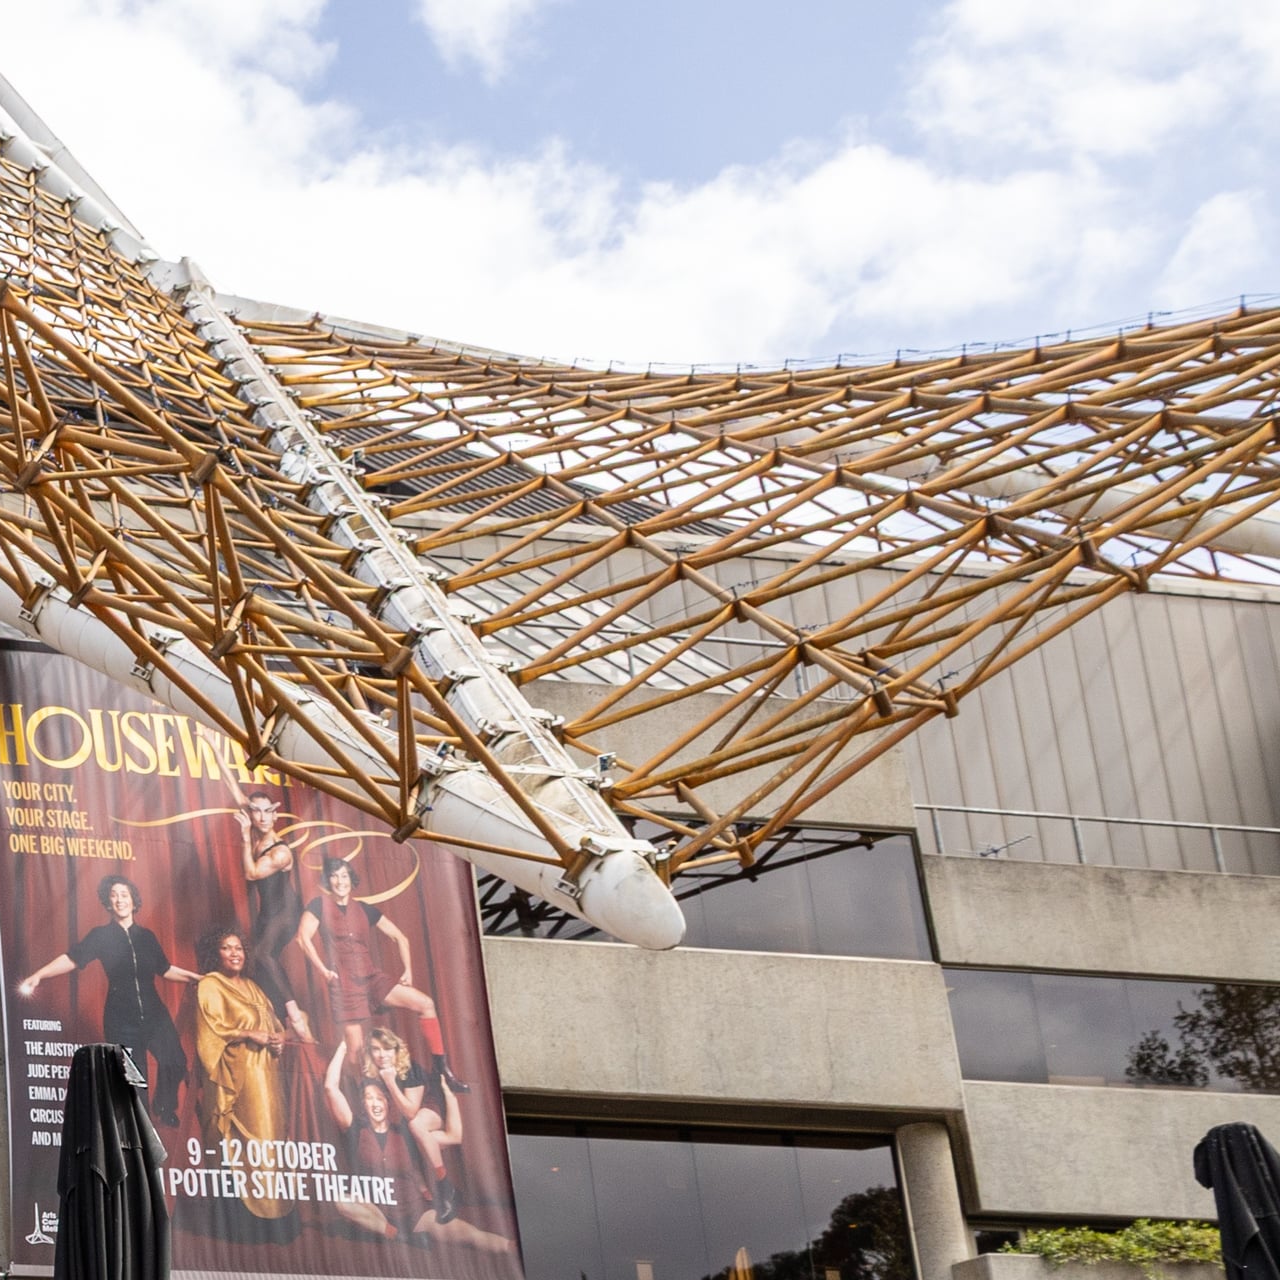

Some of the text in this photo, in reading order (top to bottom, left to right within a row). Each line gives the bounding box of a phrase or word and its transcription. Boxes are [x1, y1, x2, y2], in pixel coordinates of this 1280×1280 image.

[3, 780, 77, 803] YOUR CITY.
[6, 806, 93, 831] YOUR STAGE.
[9, 833, 136, 861] ONE BIG WEEKEND.
[23, 1018, 62, 1031] FEATURING
[24, 1041, 44, 1056] THE
[27, 1063, 70, 1079] JUDE PER
[28, 1085, 57, 1101] EMMA
[30, 1107, 65, 1124] CIRCUS
[32, 1130, 62, 1147] AND M
[187, 1137, 201, 1166] 9
[219, 1138, 244, 1167] 12
[246, 1139, 338, 1172] OCTOBER
[168, 1168, 249, 1199] POTTER
[251, 1170, 310, 1202] STATE
[311, 1173, 398, 1206] THEATRE
[42, 1211, 57, 1219] Arts
